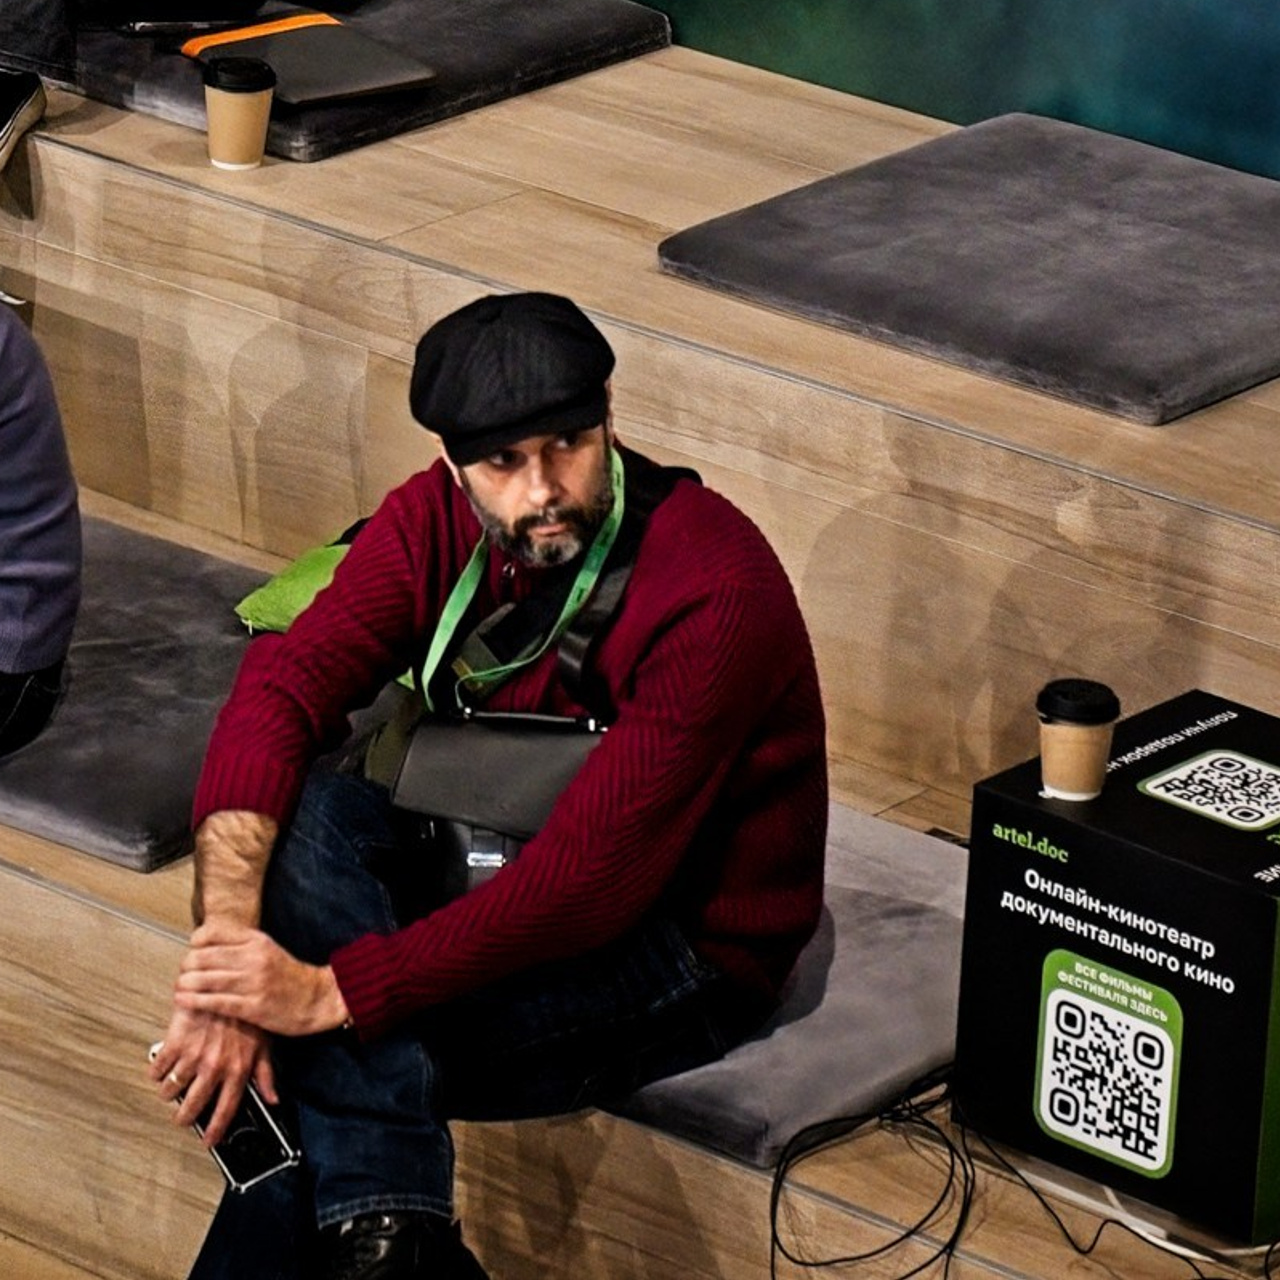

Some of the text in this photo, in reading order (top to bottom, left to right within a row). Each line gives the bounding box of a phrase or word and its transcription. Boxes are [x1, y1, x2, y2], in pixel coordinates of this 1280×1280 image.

[992, 822, 1070, 863] artel.doc
[1024, 868, 1216, 960] Онлайн-кинотеатр
[1000, 890, 1236, 994] документального кино
[1057, 970, 1169, 1022] ФЕСТИВАЛЯ ЗДЕСЬ
[1074, 961, 1154, 1002] ВСЕ ФИЛЬМЫ
